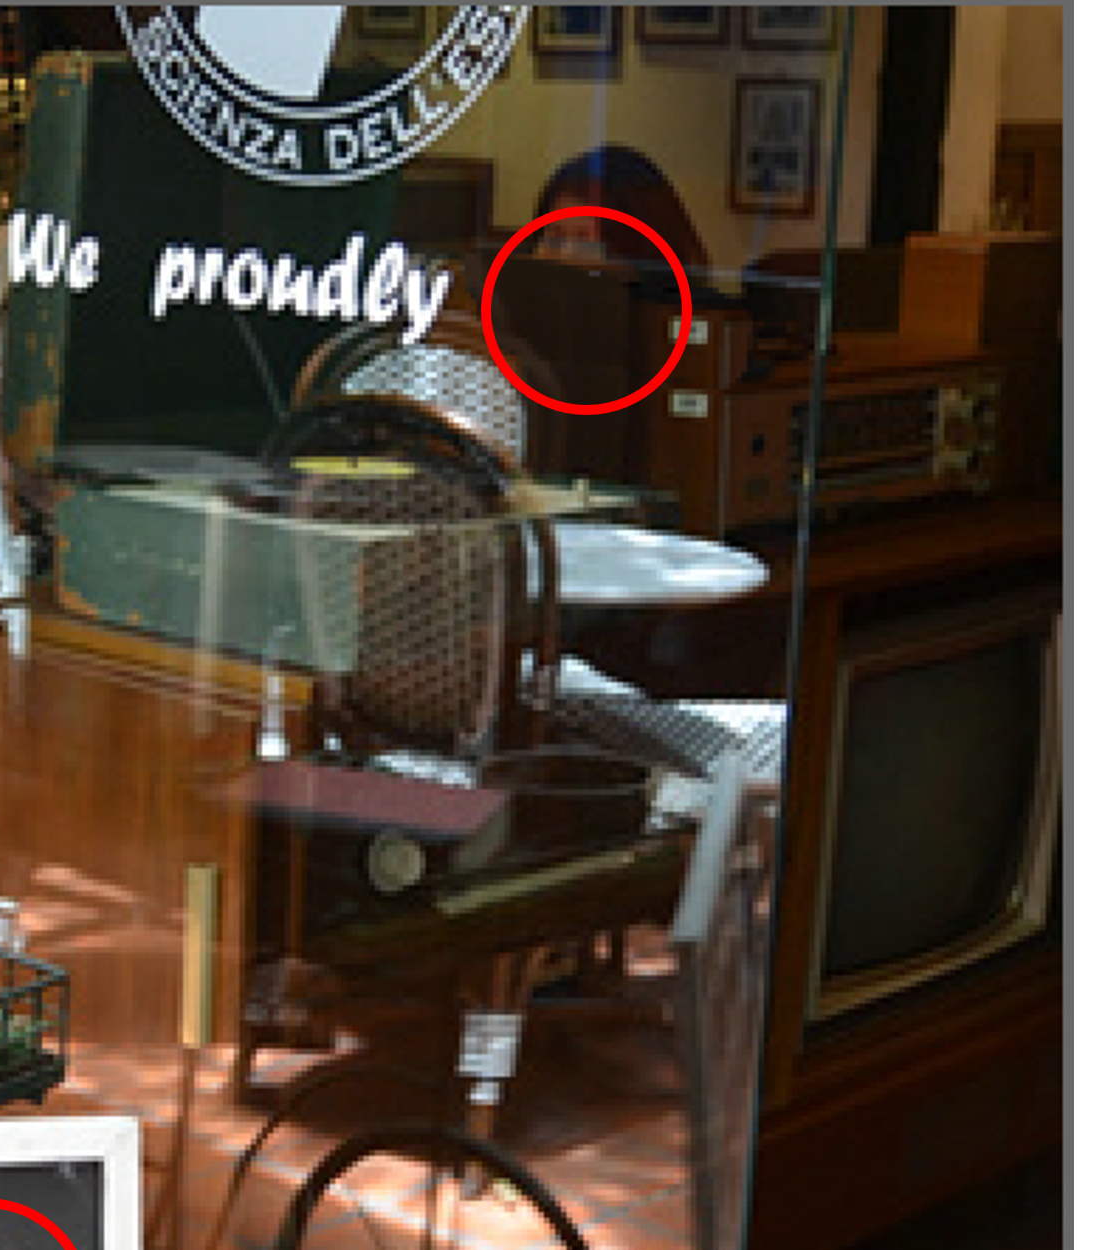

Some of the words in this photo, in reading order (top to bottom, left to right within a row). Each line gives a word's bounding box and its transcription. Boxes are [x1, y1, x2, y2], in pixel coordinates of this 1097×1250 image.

[132, 16, 304, 171] SCIENZA
[323, 6, 516, 171] DELL'ES
[7, 208, 100, 291] We
[150, 231, 451, 345] proudly
